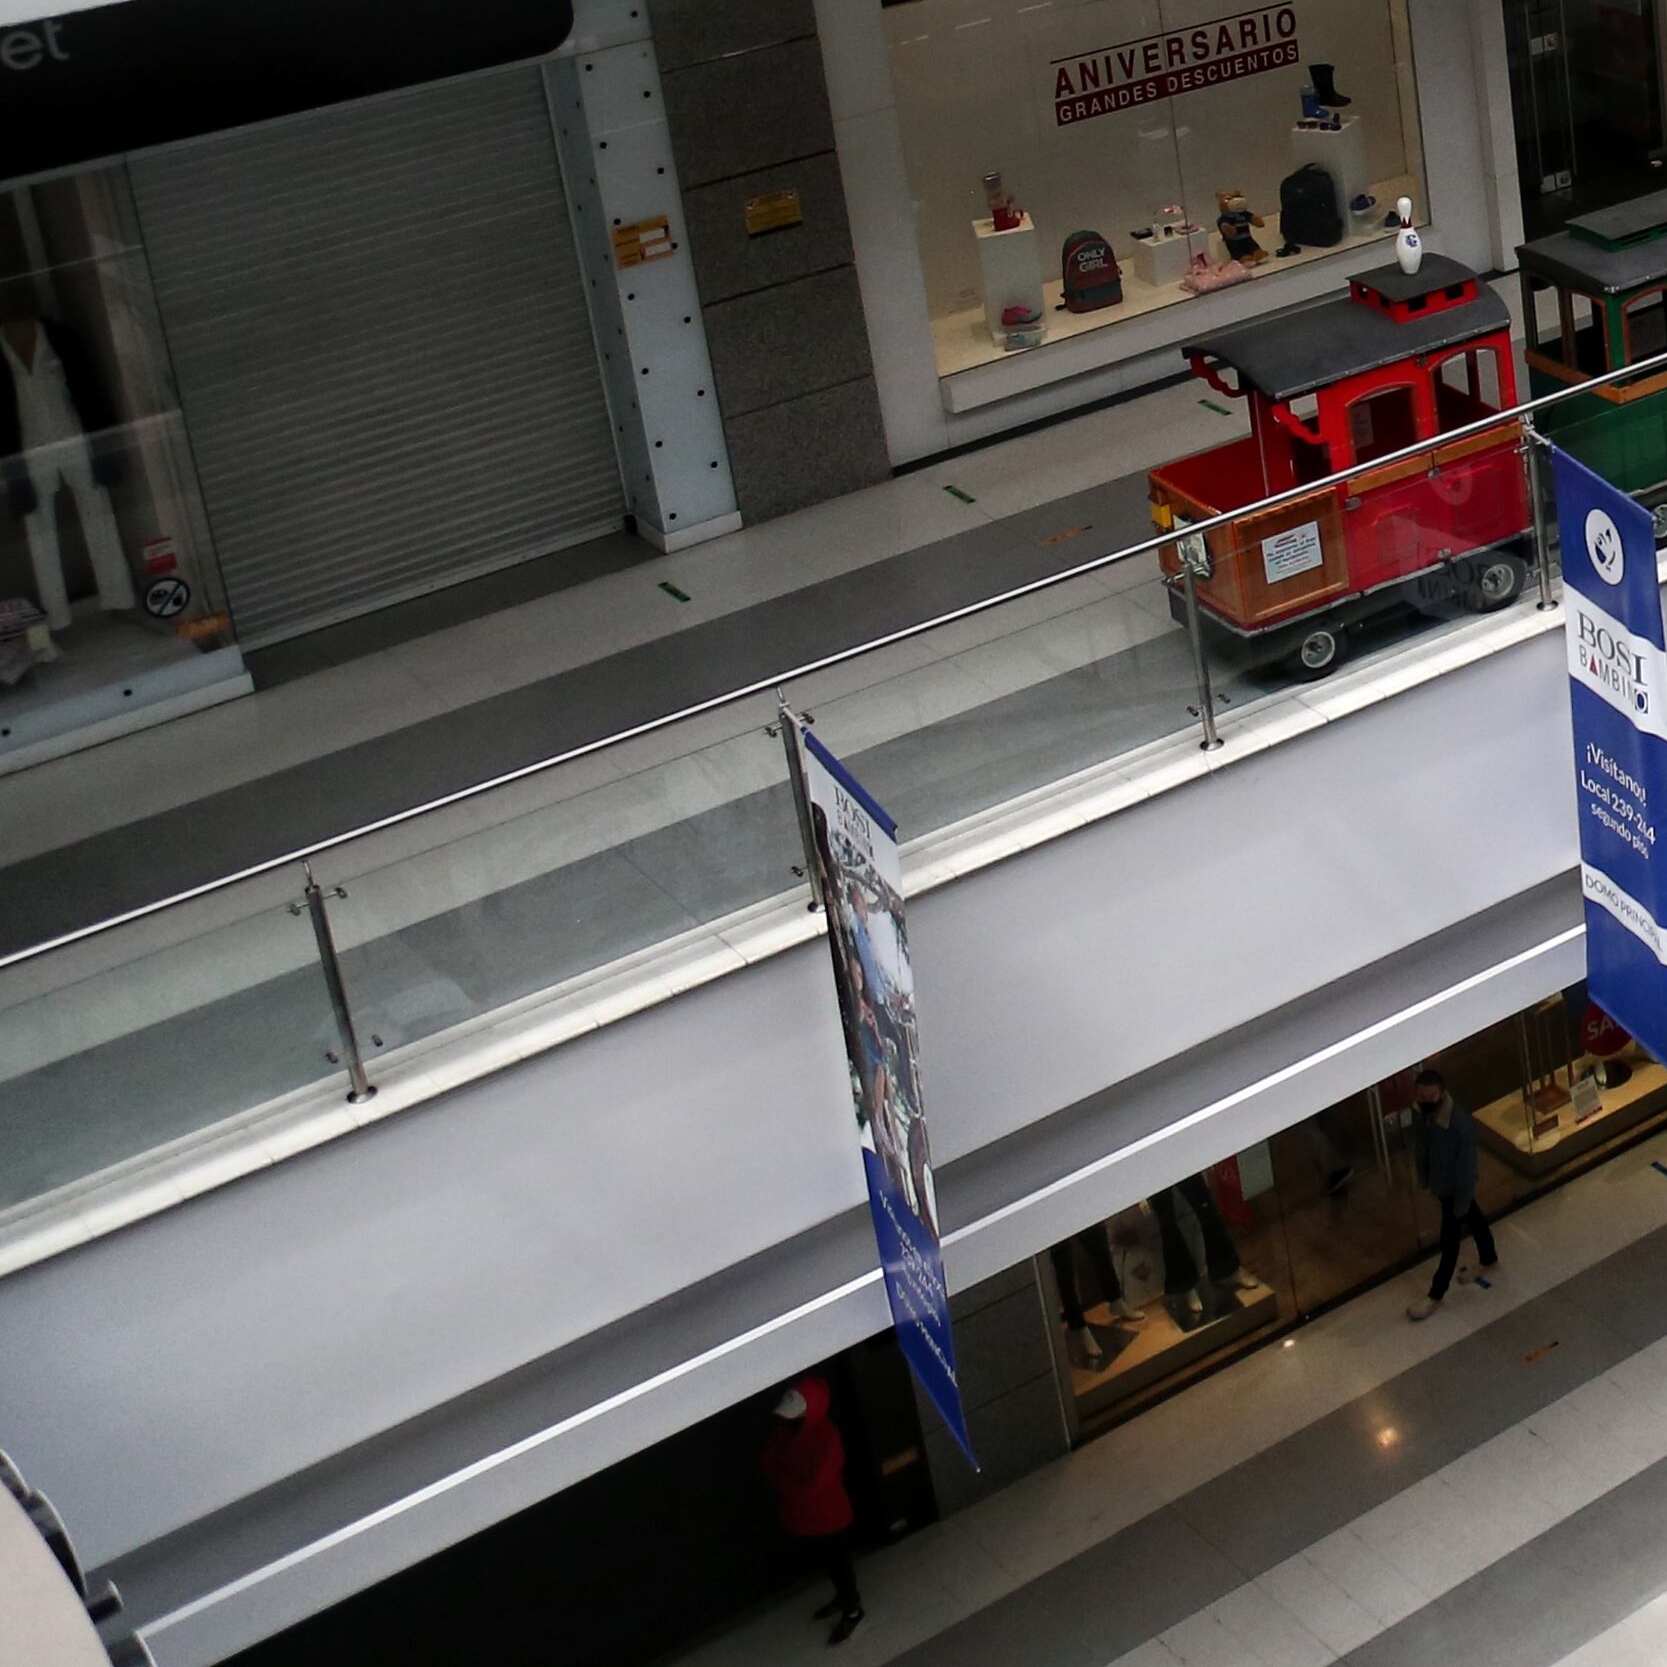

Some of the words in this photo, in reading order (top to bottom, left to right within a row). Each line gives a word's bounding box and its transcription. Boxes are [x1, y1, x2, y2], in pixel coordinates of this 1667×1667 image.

[1055, 8, 1297, 99] ANIVERSARIO
[1059, 81, 1158, 123] GRANDES
[1167, 43, 1298, 94] DESCUENTOS
[1077, 245, 1105, 262] ONLY
[1577, 610, 1650, 687] BOSI
[1580, 769, 1611, 806] Local
[1590, 802, 1632, 844] segundo
[1584, 873, 1620, 908] DOMO
